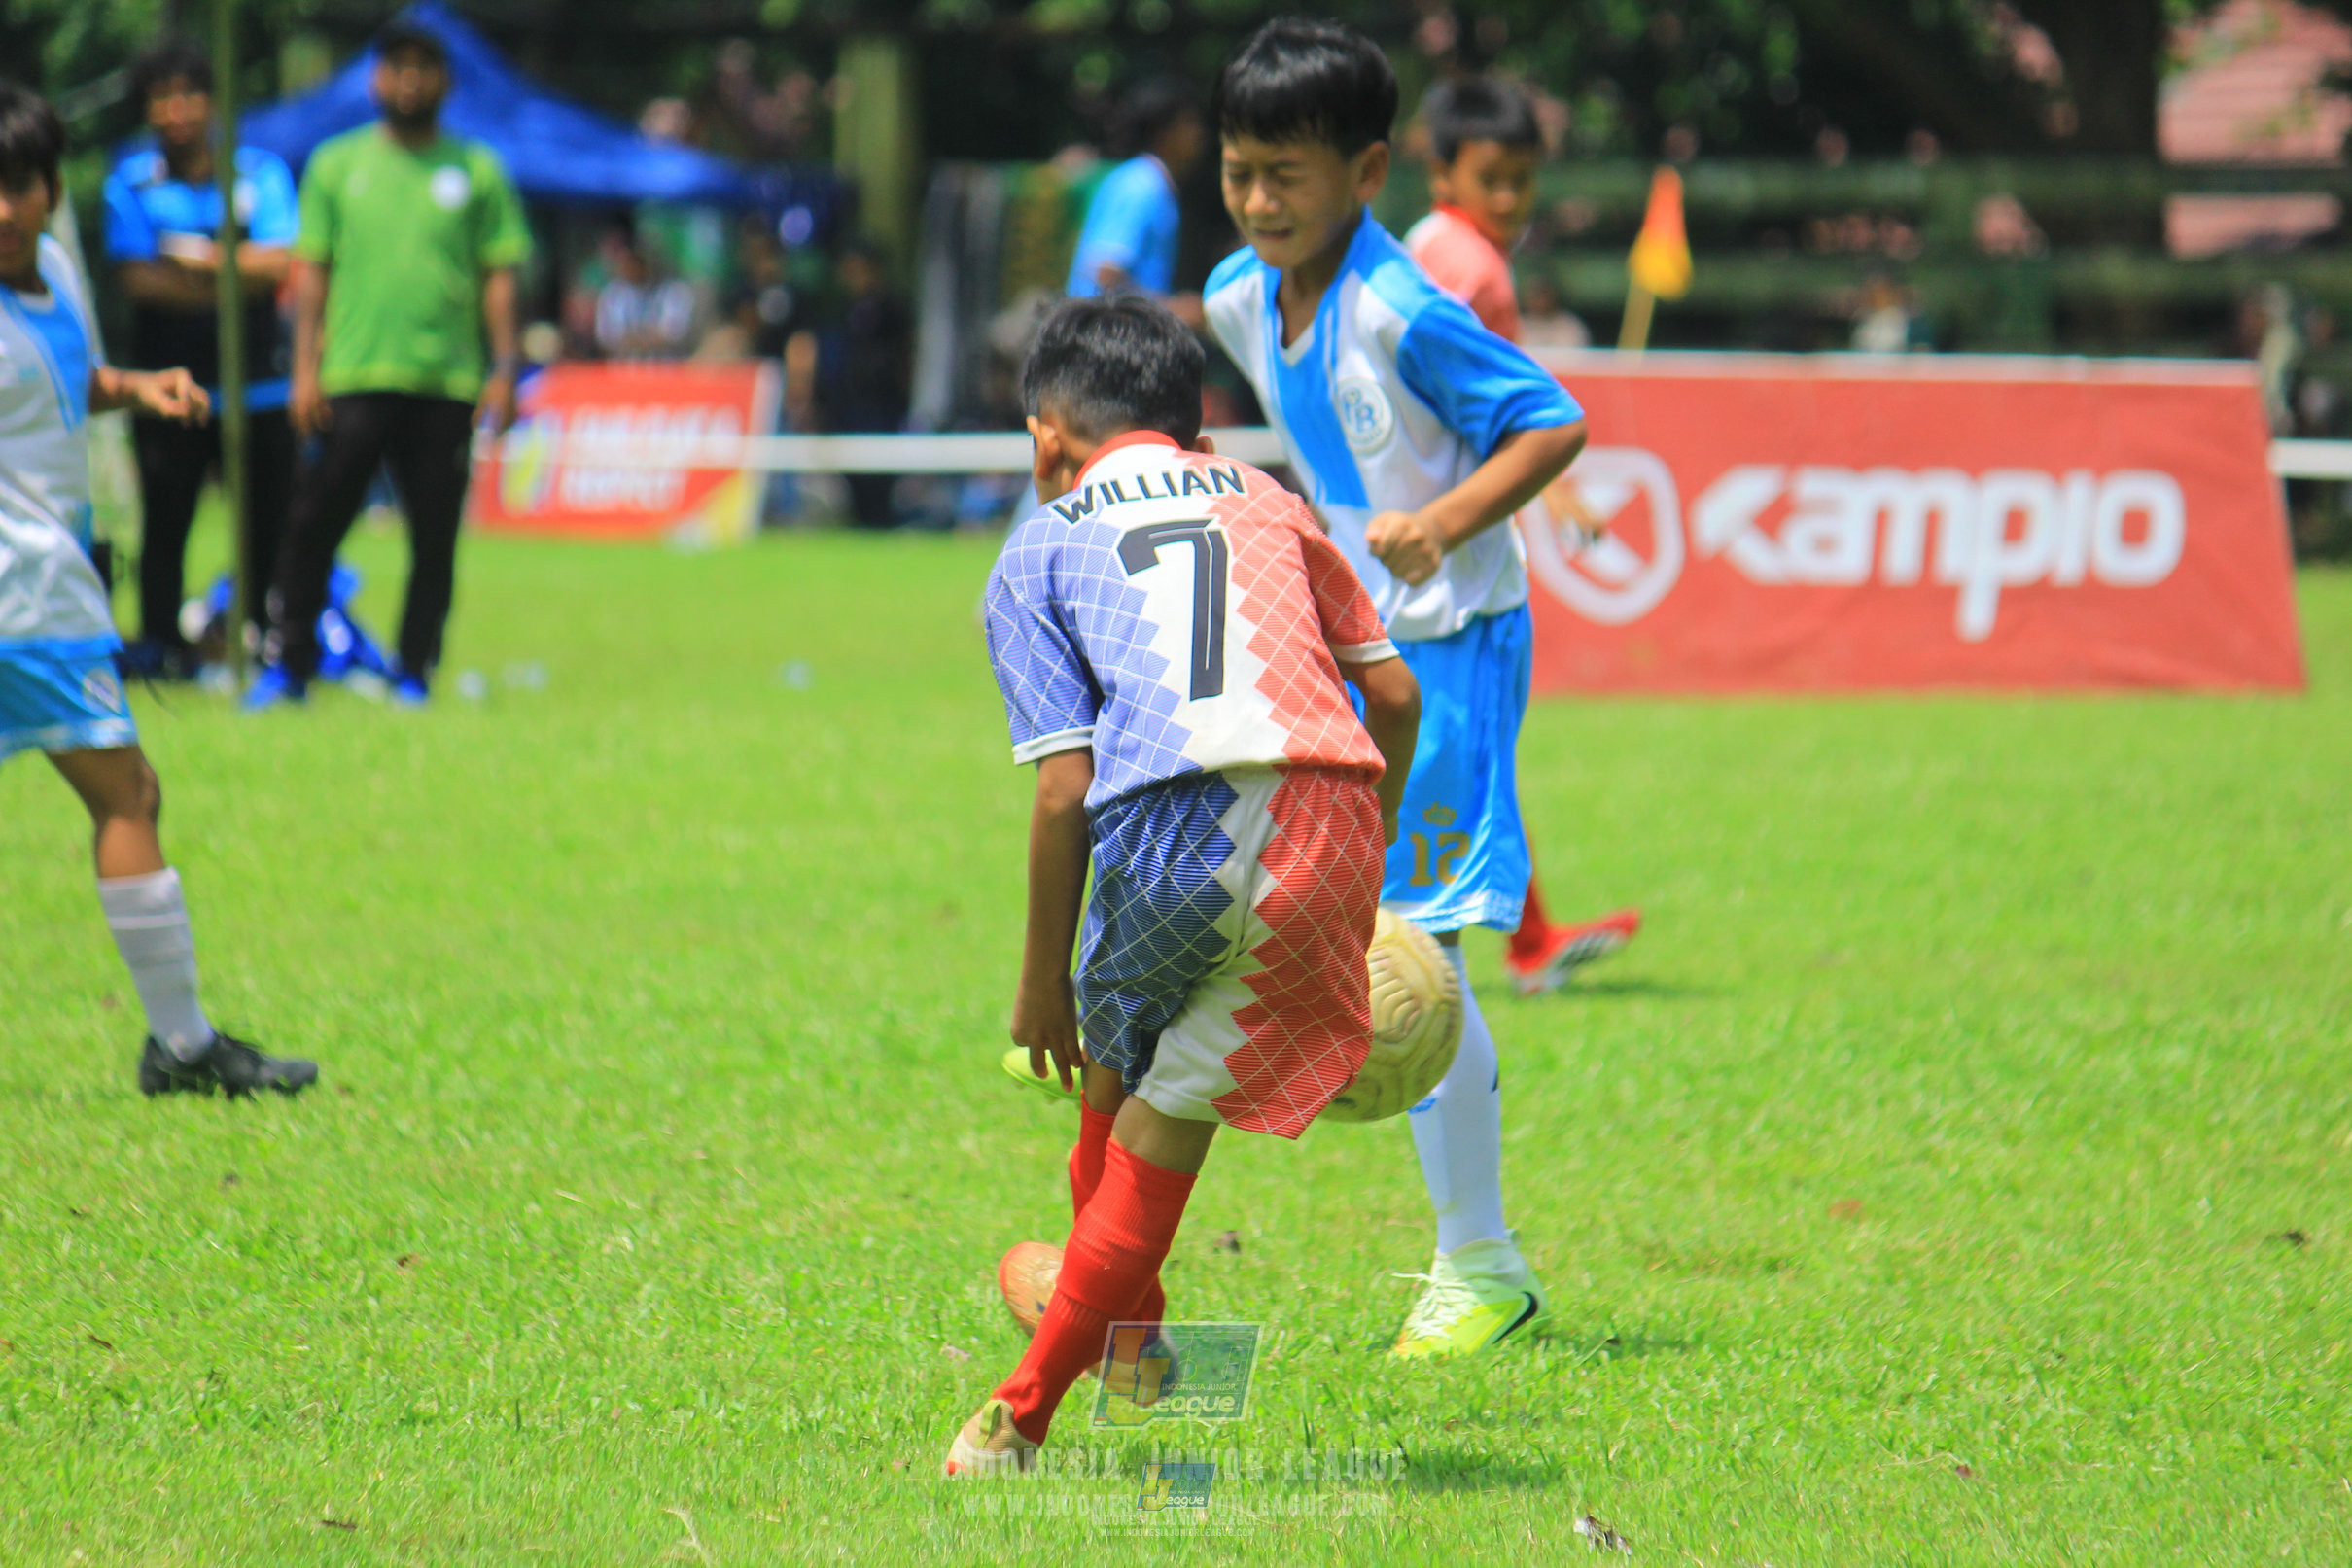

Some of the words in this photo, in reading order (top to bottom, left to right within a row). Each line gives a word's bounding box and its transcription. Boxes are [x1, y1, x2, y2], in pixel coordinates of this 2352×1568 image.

[1051, 463, 1246, 526] WILLIAN
[1116, 517, 1229, 702] 7
[1410, 830, 1472, 887] 12
